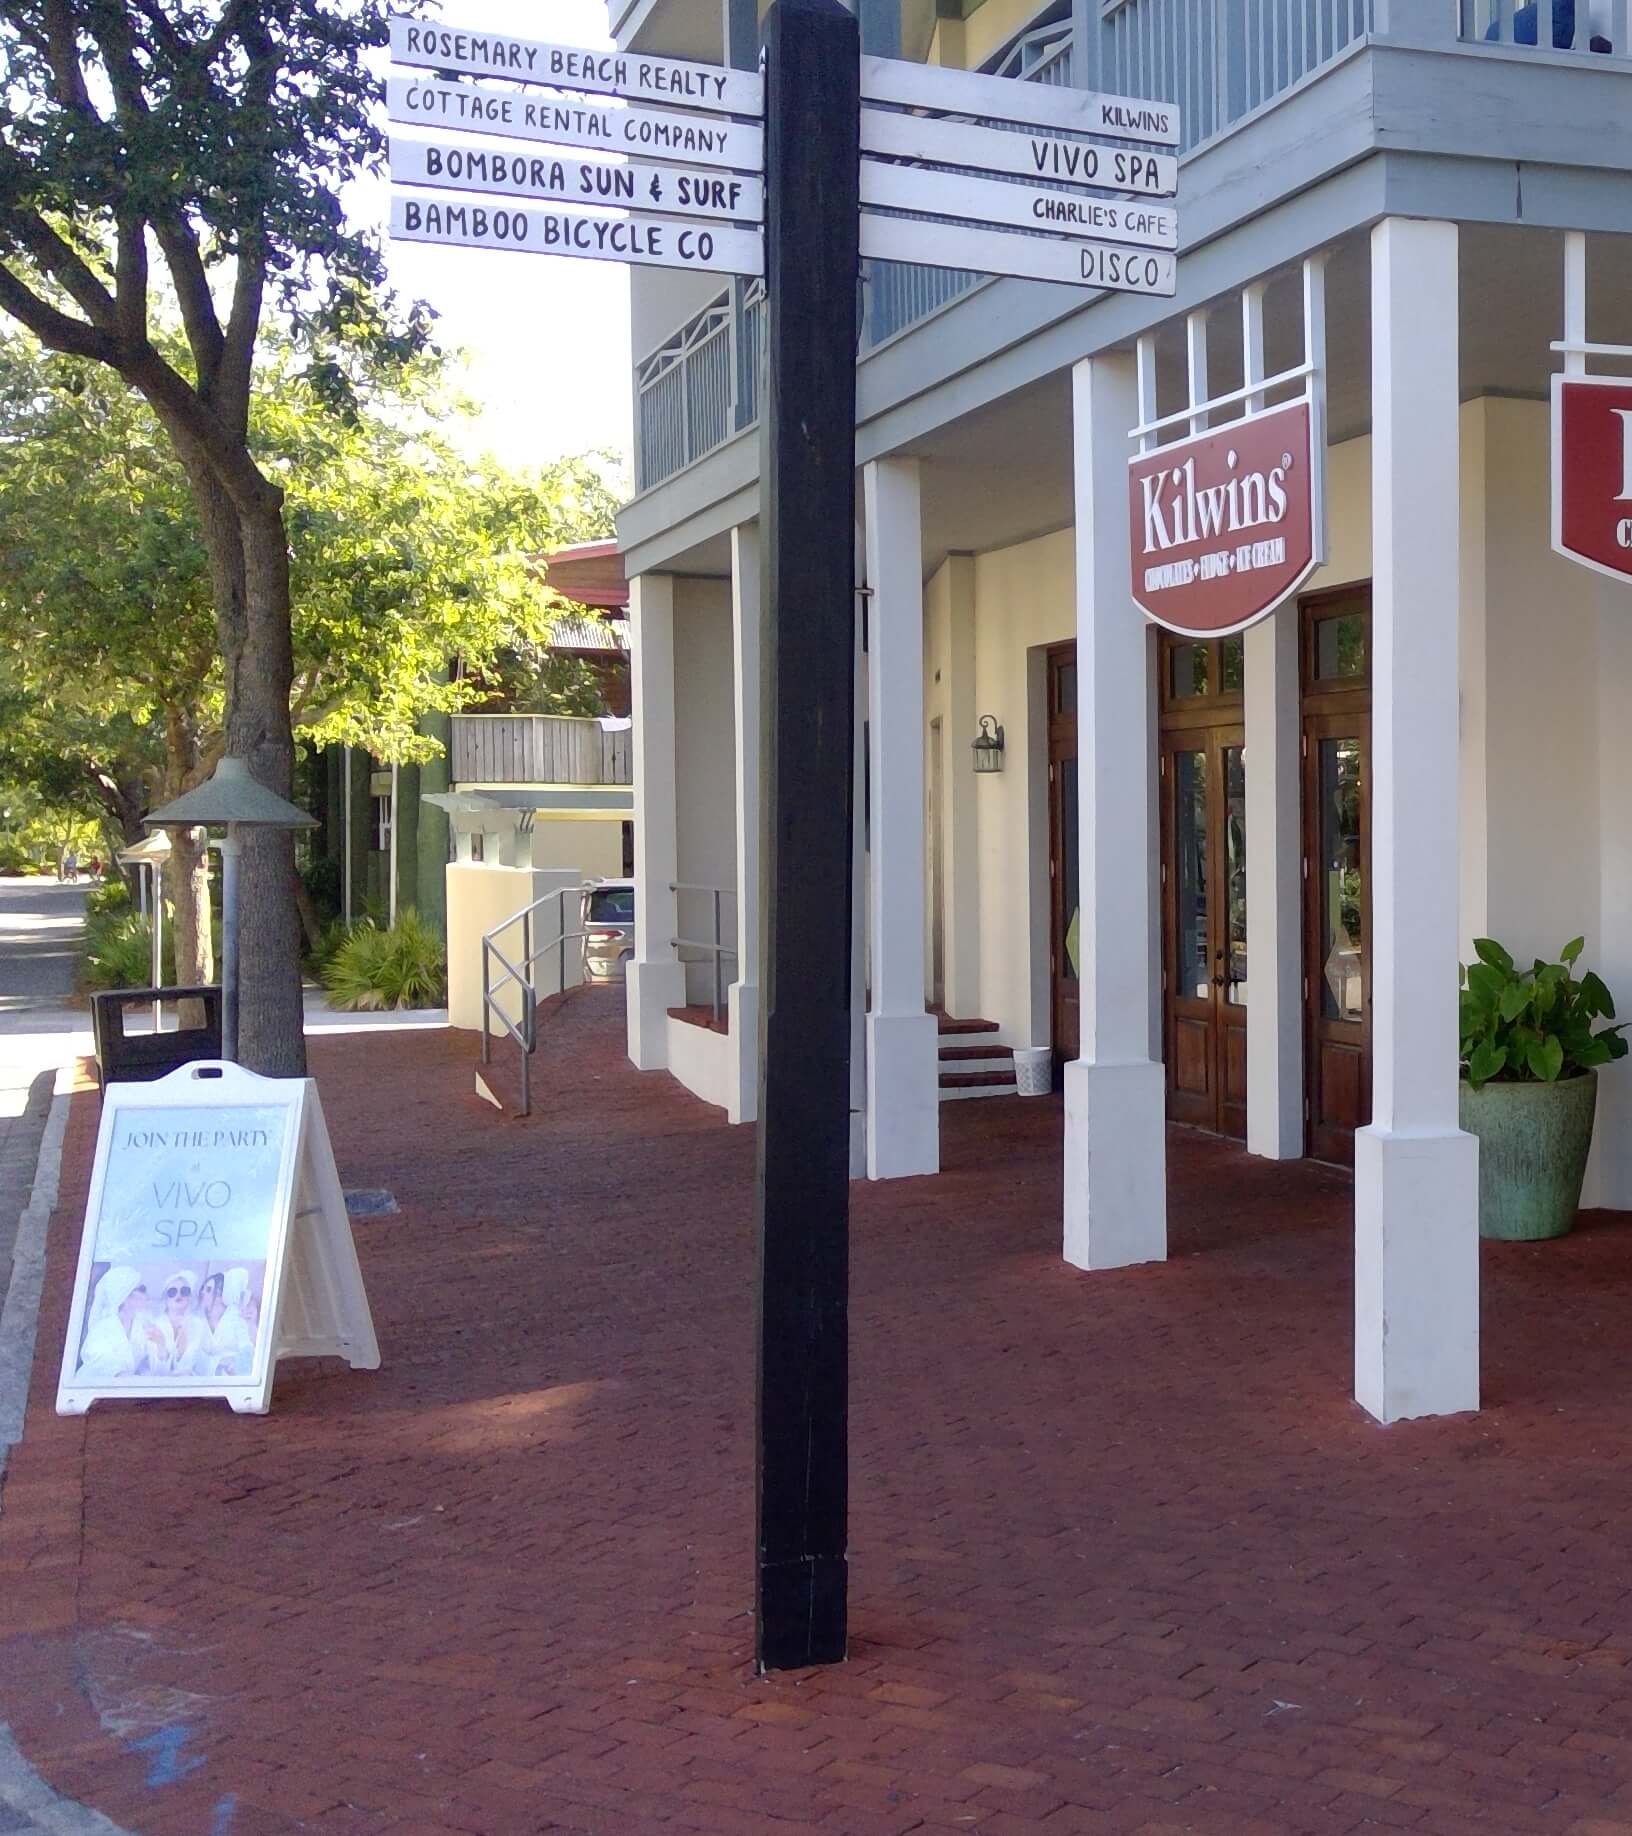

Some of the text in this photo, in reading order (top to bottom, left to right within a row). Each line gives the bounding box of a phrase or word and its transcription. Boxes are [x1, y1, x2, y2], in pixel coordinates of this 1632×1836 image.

[407, 27, 728, 100] ROSEMARY BEACH REALTY
[406, 87, 728, 153] COTTAGE RENTAL COMPANY
[1102, 104, 1169, 134] KILWINS
[426, 147, 743, 210] BOMBORA SUN & SURF
[1031, 140, 1160, 189] VIVO SPA
[405, 202, 714, 261] BAMBOO BICYCLE CO
[1033, 197, 1168, 236] CHARLIE'S CAFE
[1081, 248, 1160, 287] DISCO
[122, 1129, 271, 1150] JOIN THE PARTY
[153, 1180, 232, 1209] VIVO
[151, 1219, 218, 1248] SPA
